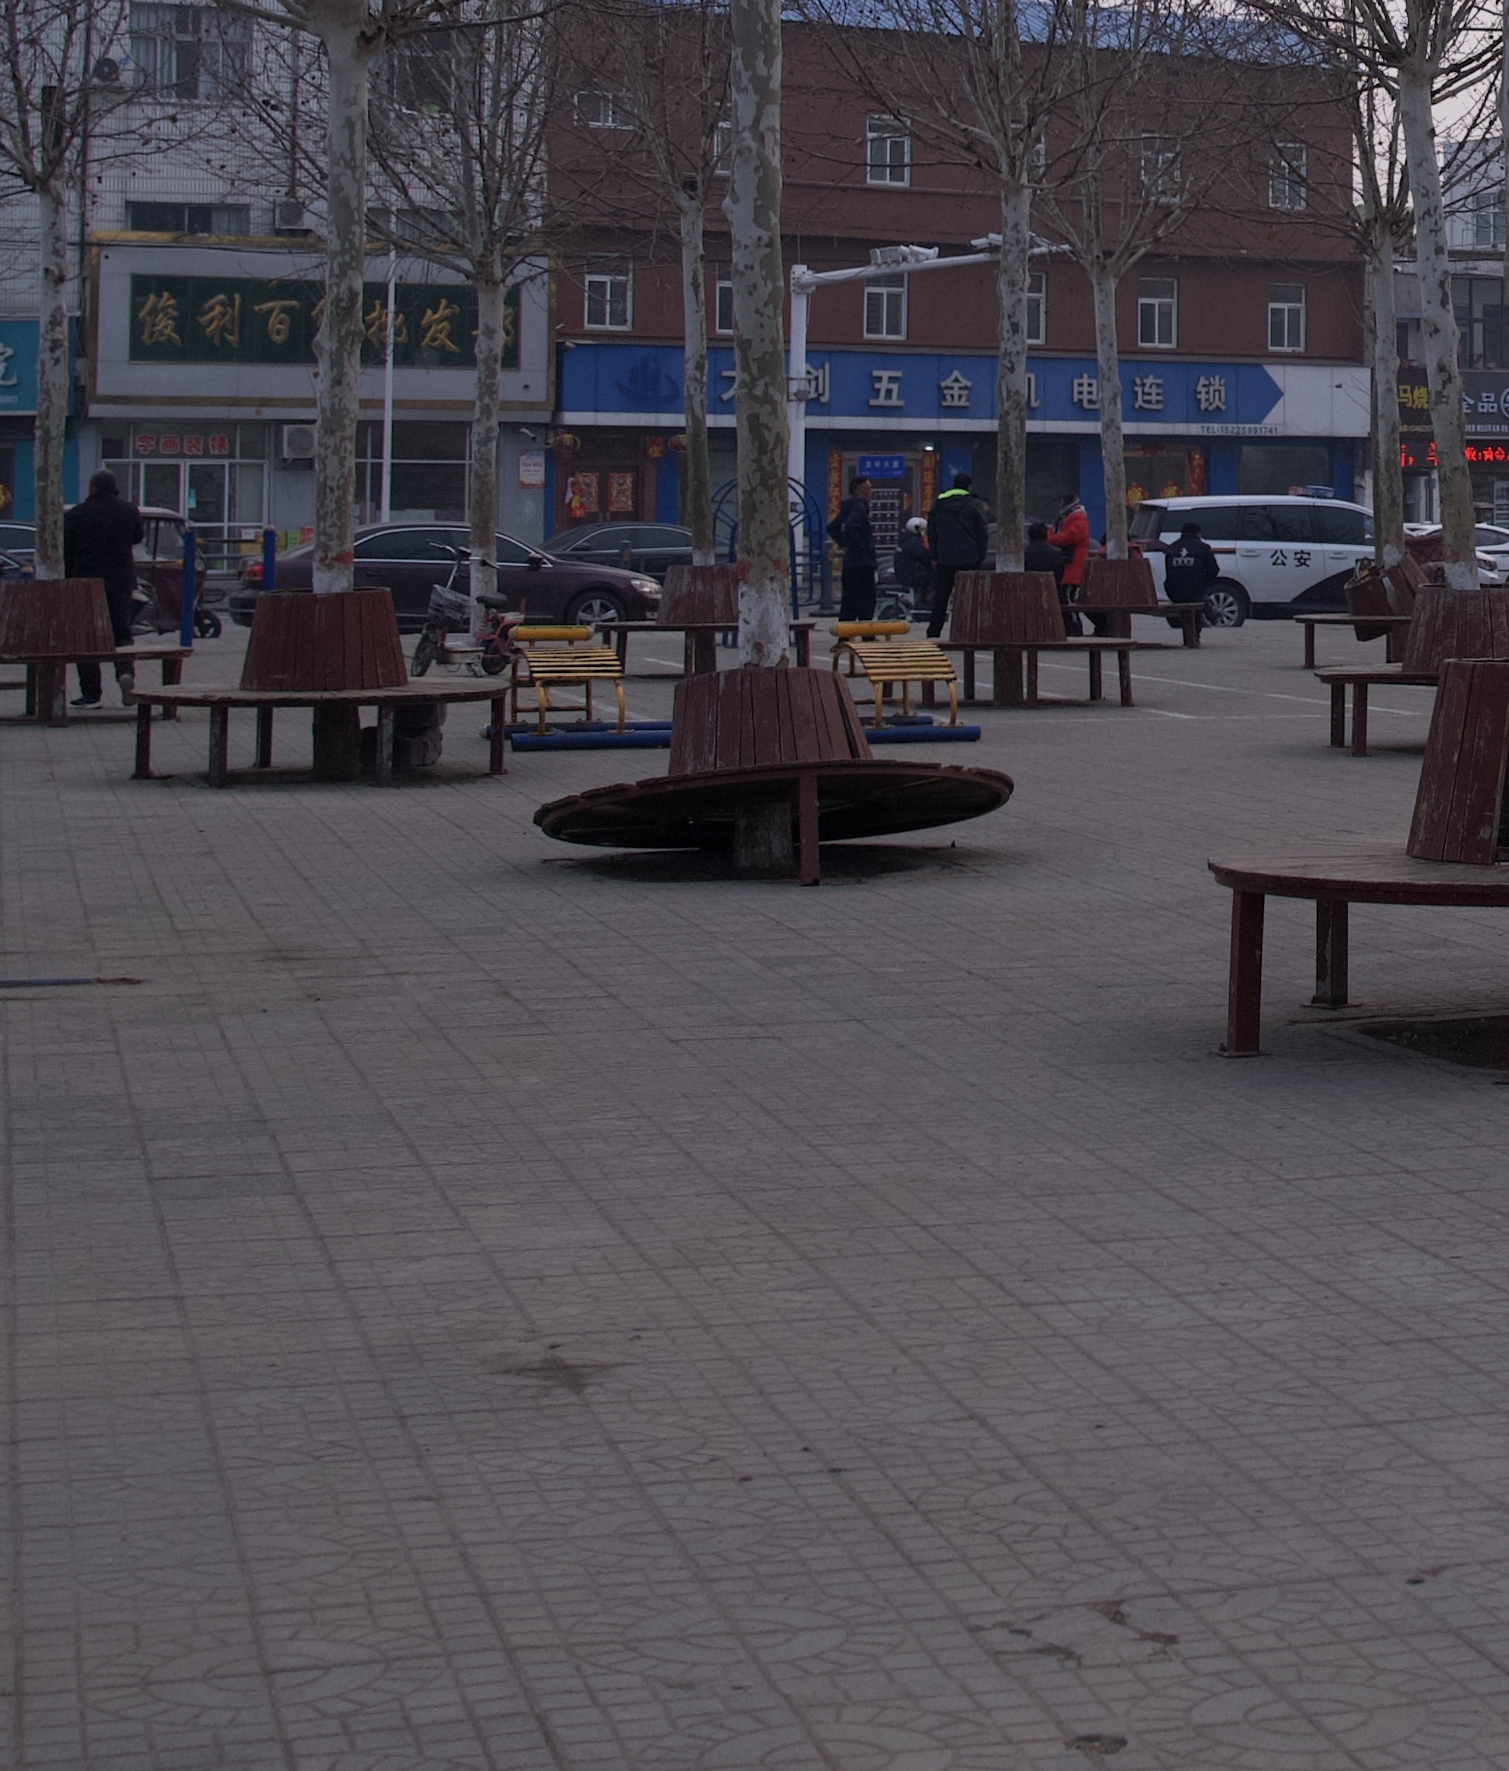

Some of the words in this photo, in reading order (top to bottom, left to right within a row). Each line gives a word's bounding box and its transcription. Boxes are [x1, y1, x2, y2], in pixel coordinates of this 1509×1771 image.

[137, 290, 516, 355] 俊利百批发
[1269, 548, 1313, 569] 公安
